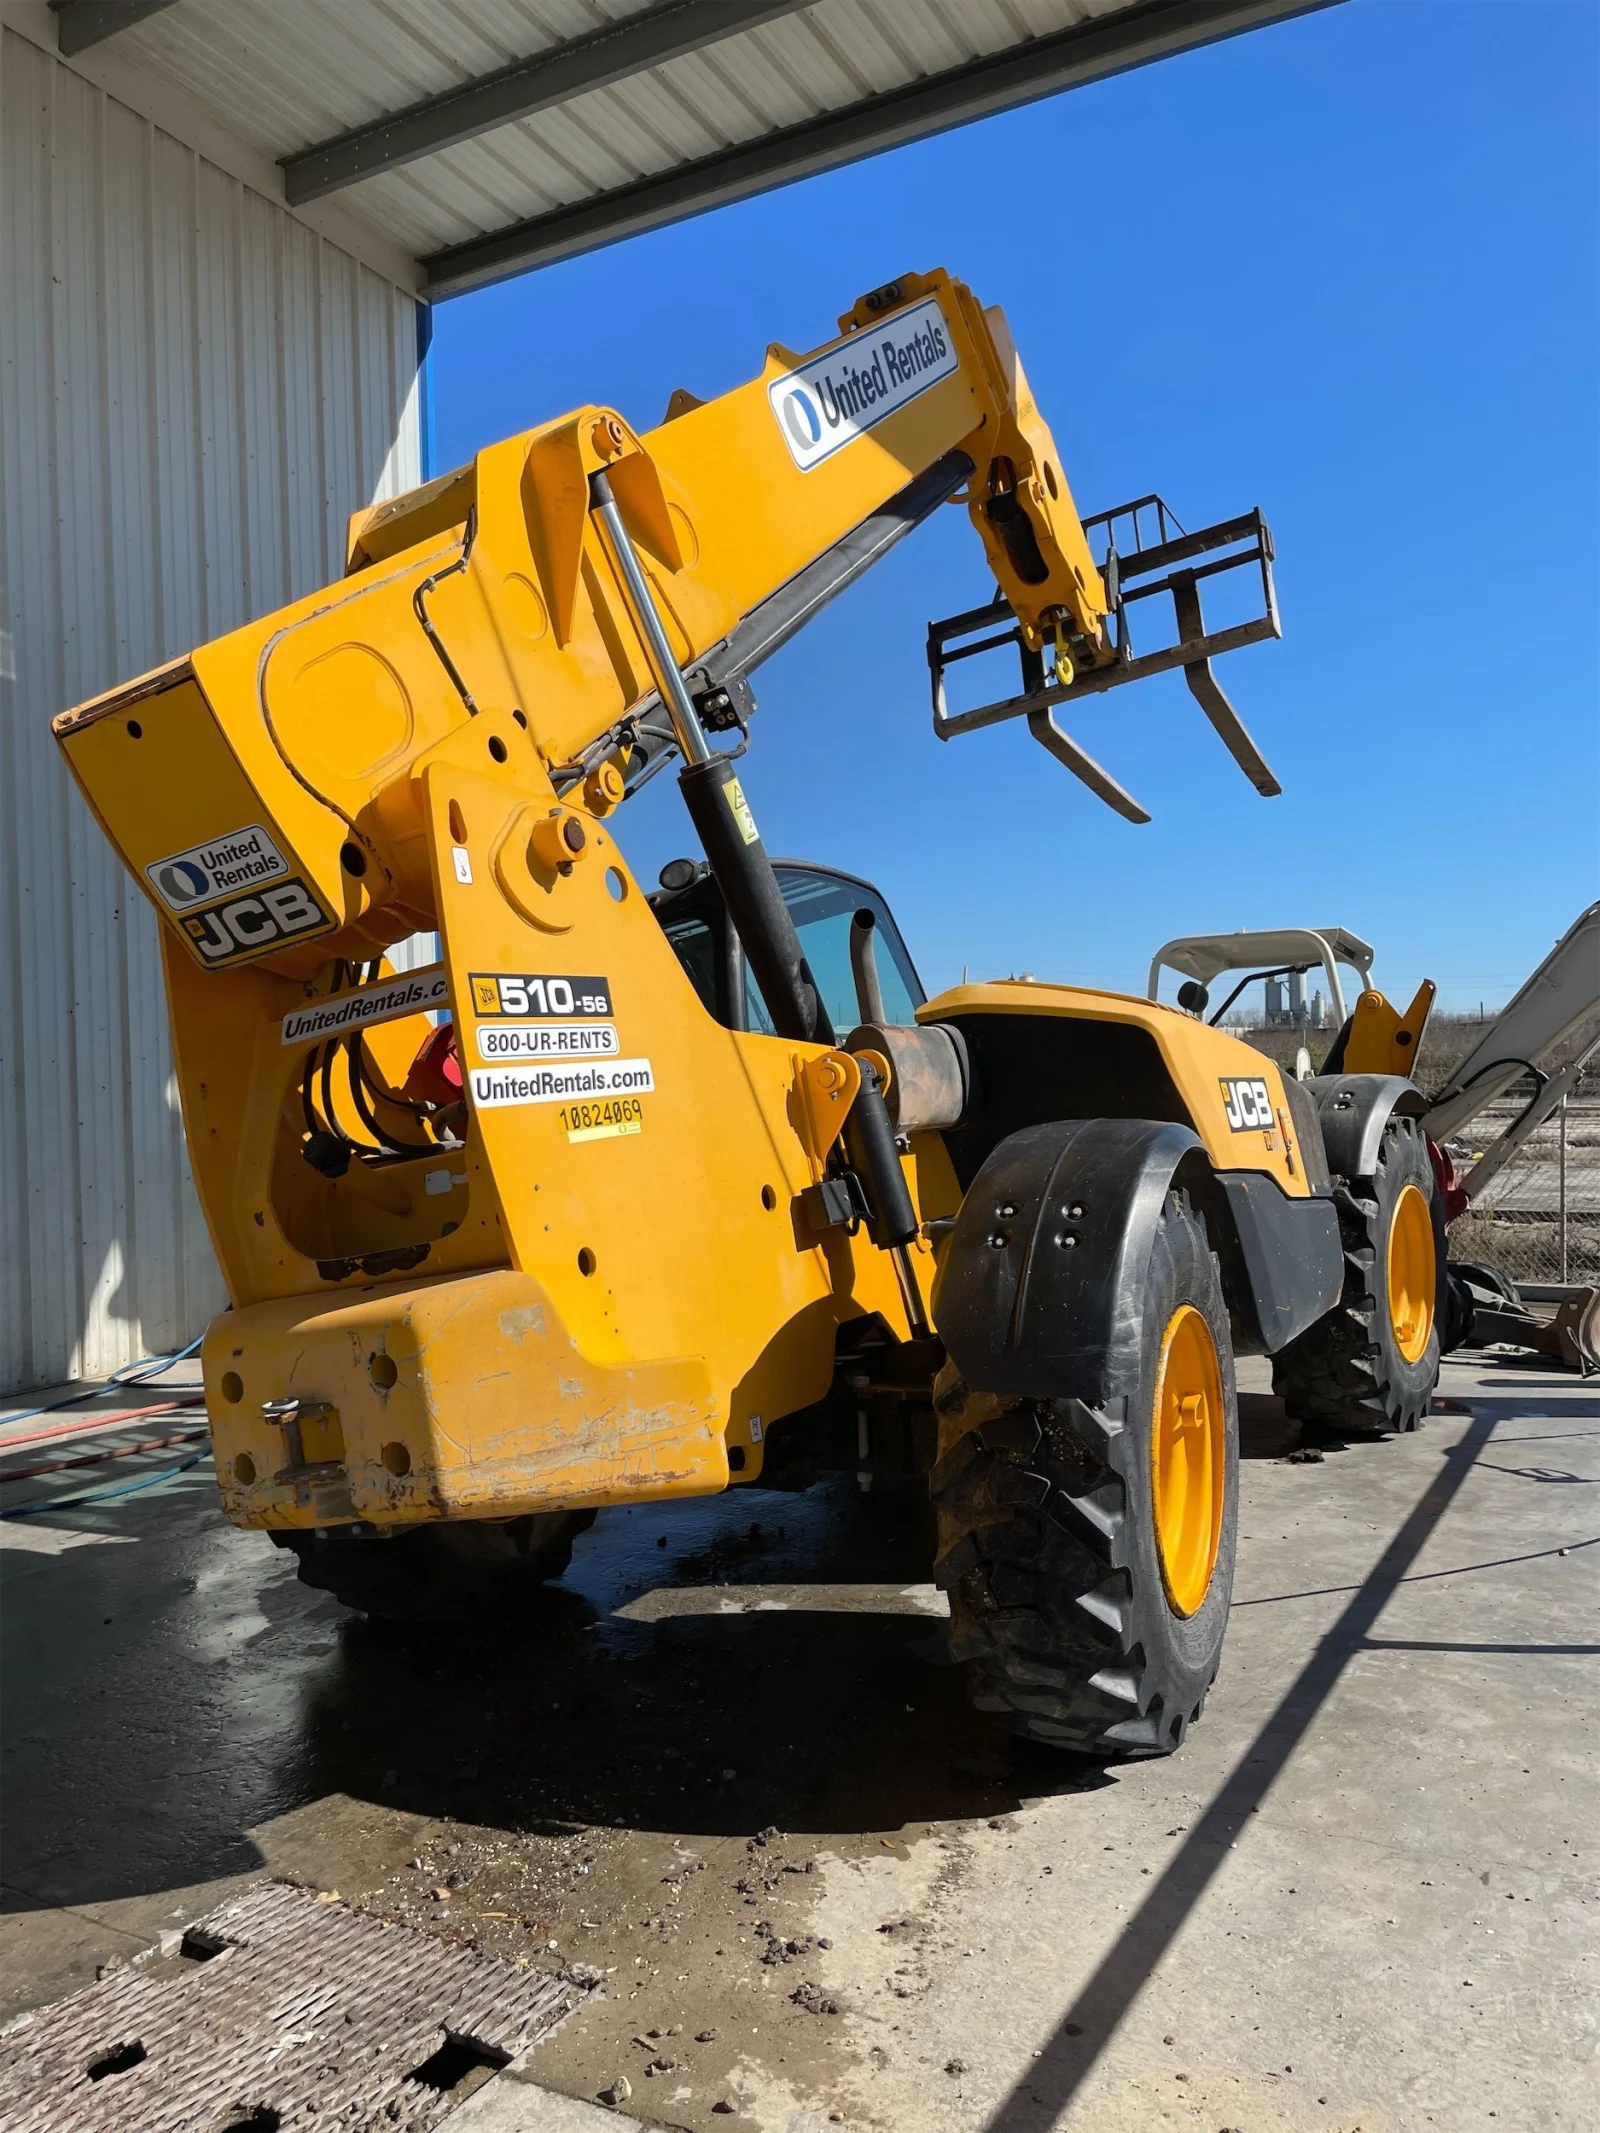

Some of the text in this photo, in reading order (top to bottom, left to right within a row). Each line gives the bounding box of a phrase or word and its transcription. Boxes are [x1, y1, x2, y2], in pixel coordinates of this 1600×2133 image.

[814, 319, 947, 429] United Rentals
[199, 834, 280, 889] United Rentals
[197, 884, 322, 958] JCB
[284, 979, 449, 1039] UnitedRentals.c
[498, 978, 608, 1014] 510-56
[487, 1030, 612, 1053] 800-UR-RENTS
[476, 1068, 650, 1101] UnitedRentals.com
[1226, 1081, 1274, 1128] JCB
[559, 1098, 643, 1131] 10824069
